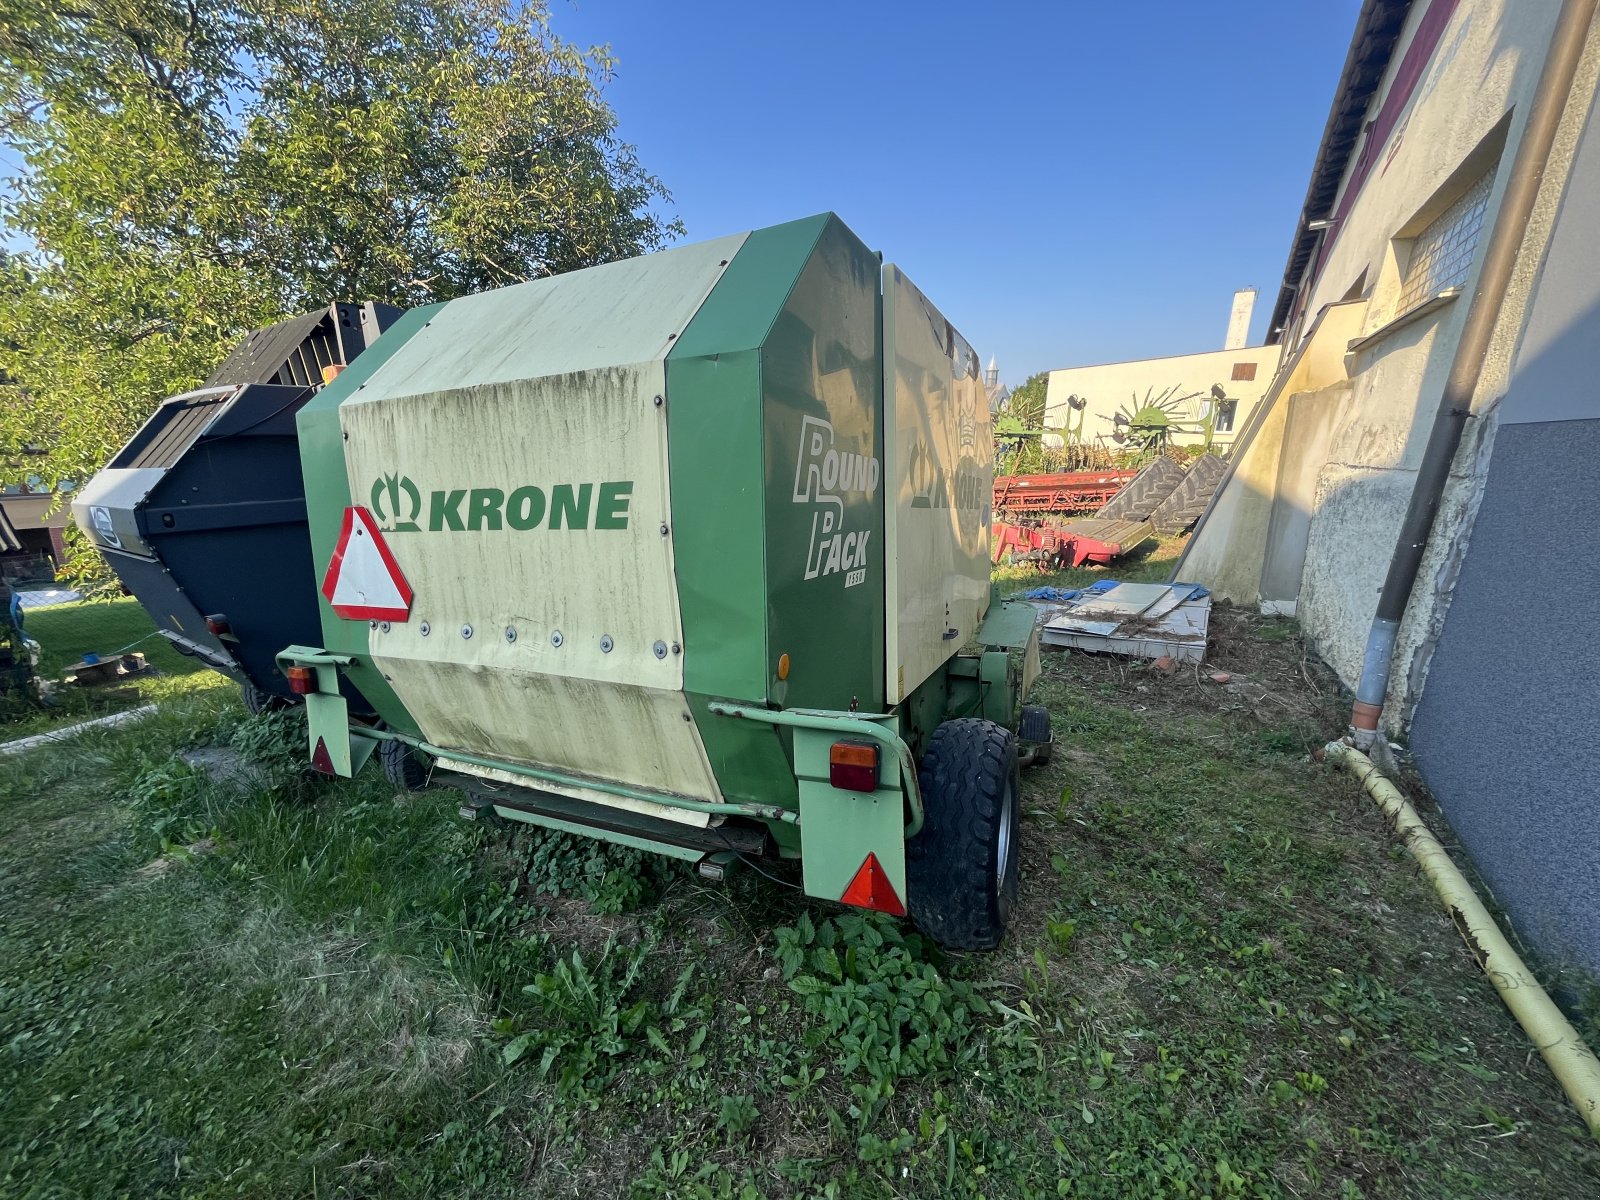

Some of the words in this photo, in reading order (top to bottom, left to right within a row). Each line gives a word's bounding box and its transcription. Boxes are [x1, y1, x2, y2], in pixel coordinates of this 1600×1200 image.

[793, 415, 879, 503] ROUND
[933, 465, 983, 509] KONE
[429, 481, 634, 532] KRONE
[804, 500, 871, 581] PACK
